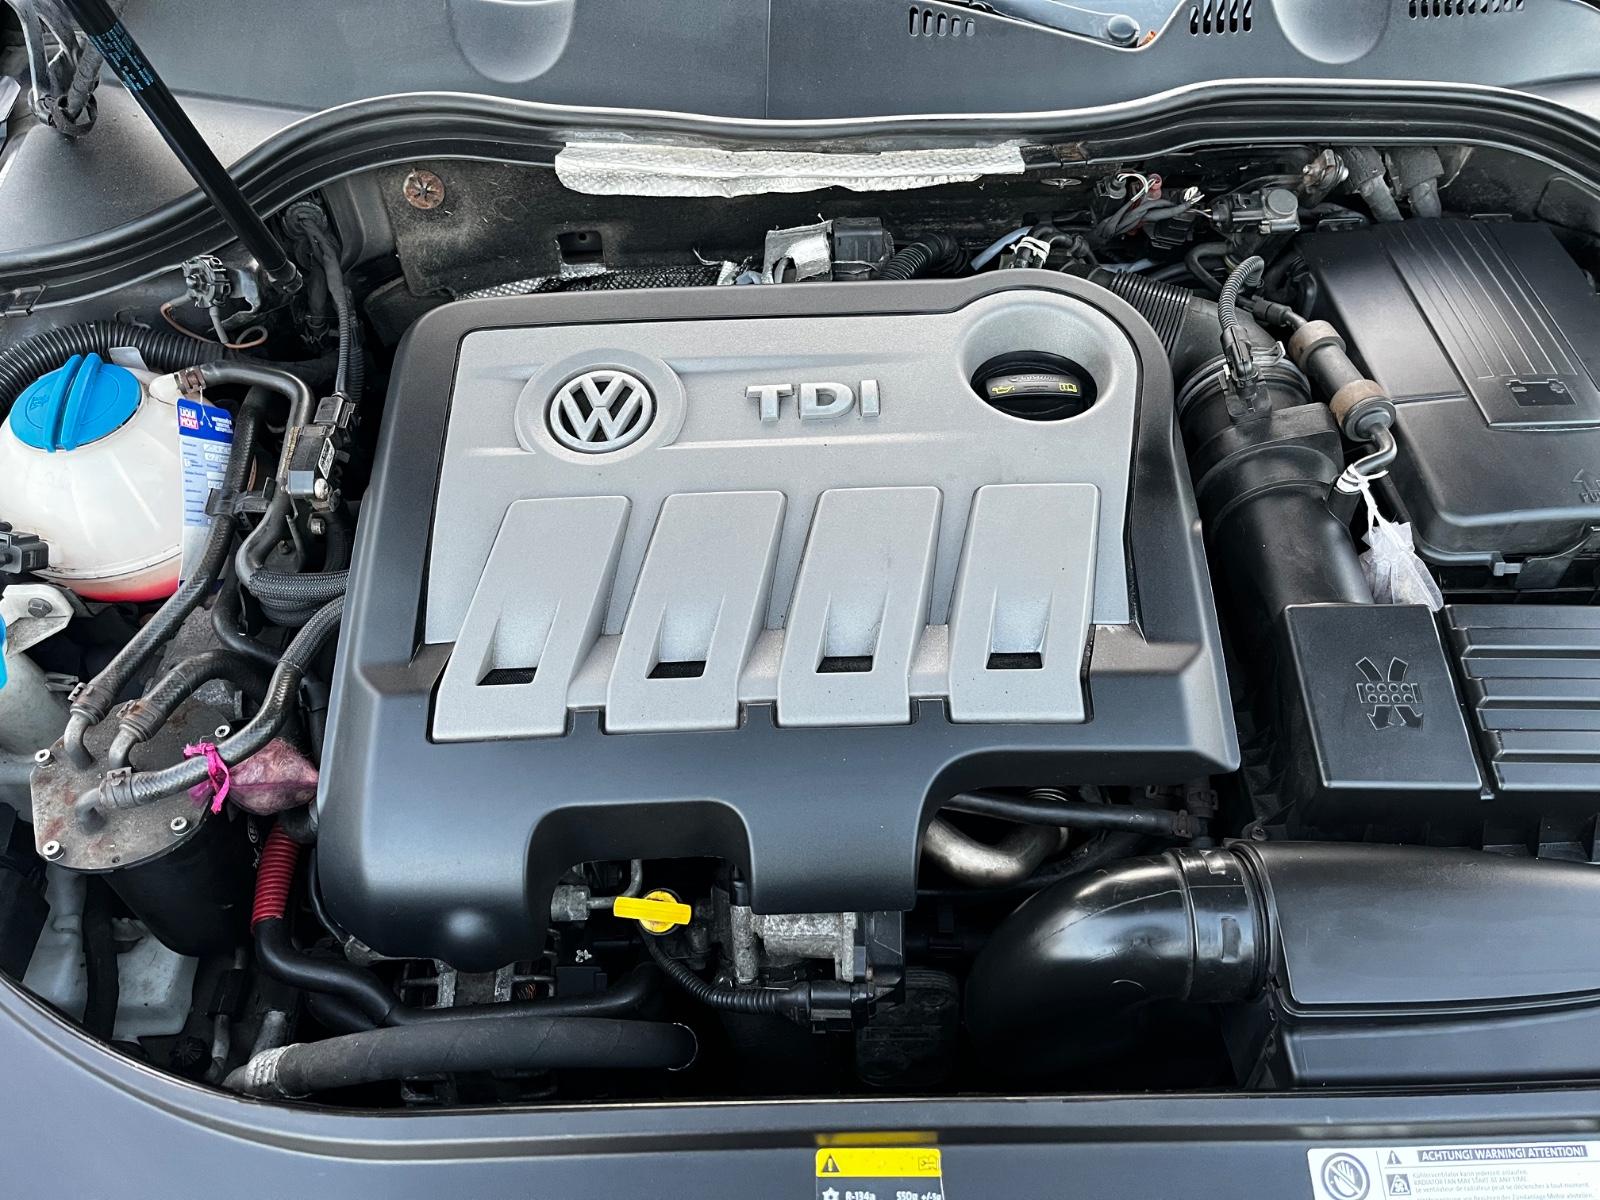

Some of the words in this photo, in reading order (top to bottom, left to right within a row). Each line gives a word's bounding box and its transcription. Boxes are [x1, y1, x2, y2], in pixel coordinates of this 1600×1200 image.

[553, 371, 650, 448] VW
[745, 379, 881, 422] TDI
[180, 417, 199, 430] MOLY
[1422, 1149, 1474, 1161] ACHTUNG!
[1475, 1148, 1526, 1160] WARNING!
[1528, 1146, 1585, 1158] ATTENTION!
